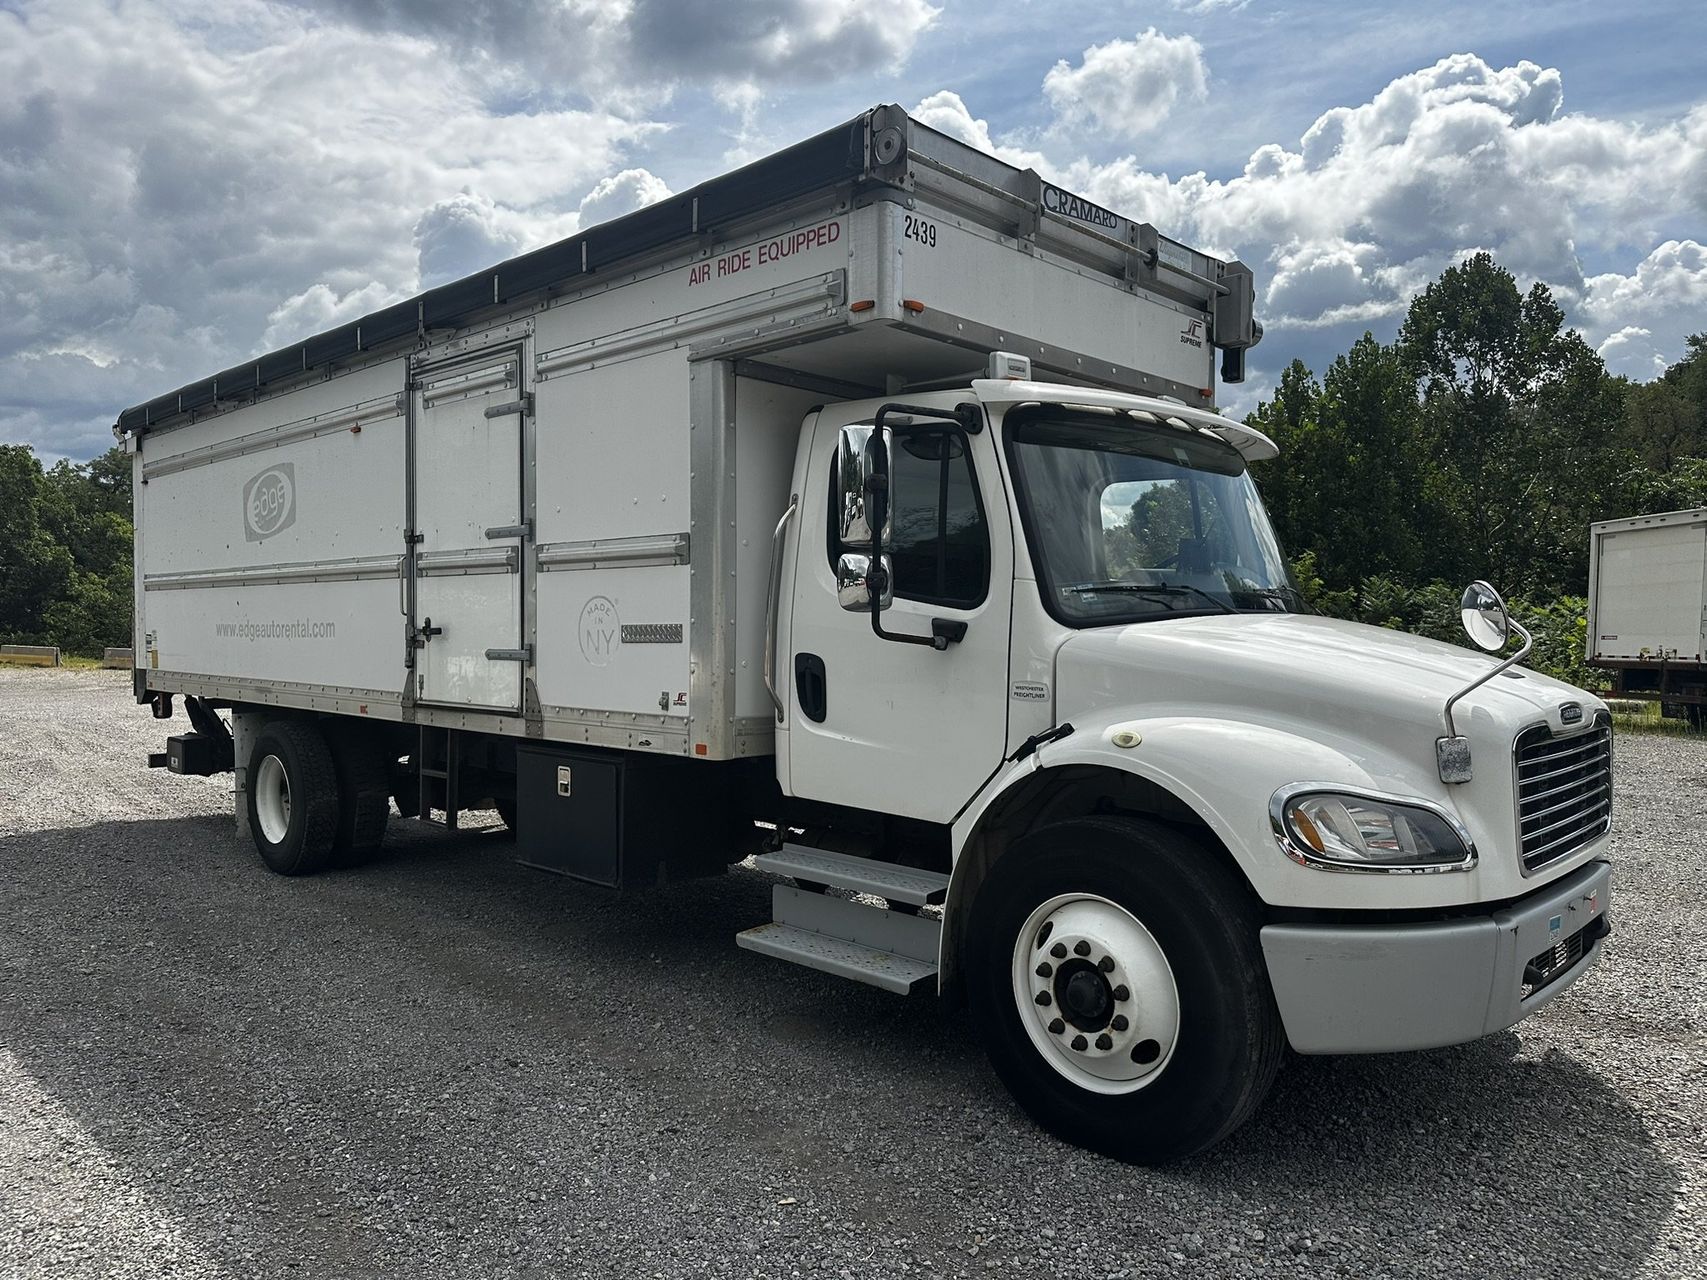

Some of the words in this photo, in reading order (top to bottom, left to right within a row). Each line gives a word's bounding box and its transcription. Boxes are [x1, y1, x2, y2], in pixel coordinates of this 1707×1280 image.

[1043, 184, 1117, 229] CRAMARO
[904, 214, 937, 248] 2439
[688, 264, 711, 287] AIR
[717, 251, 751, 277] RIDE
[758, 221, 840, 265] EQUIPPED
[1180, 335, 1202, 348] SUPREME
[252, 483, 286, 522] edge
[587, 603, 610, 617] MADE
[594, 617, 604, 625] IN
[215, 617, 336, 642] www.edgeautorental.com
[586, 629, 615, 656] NY
